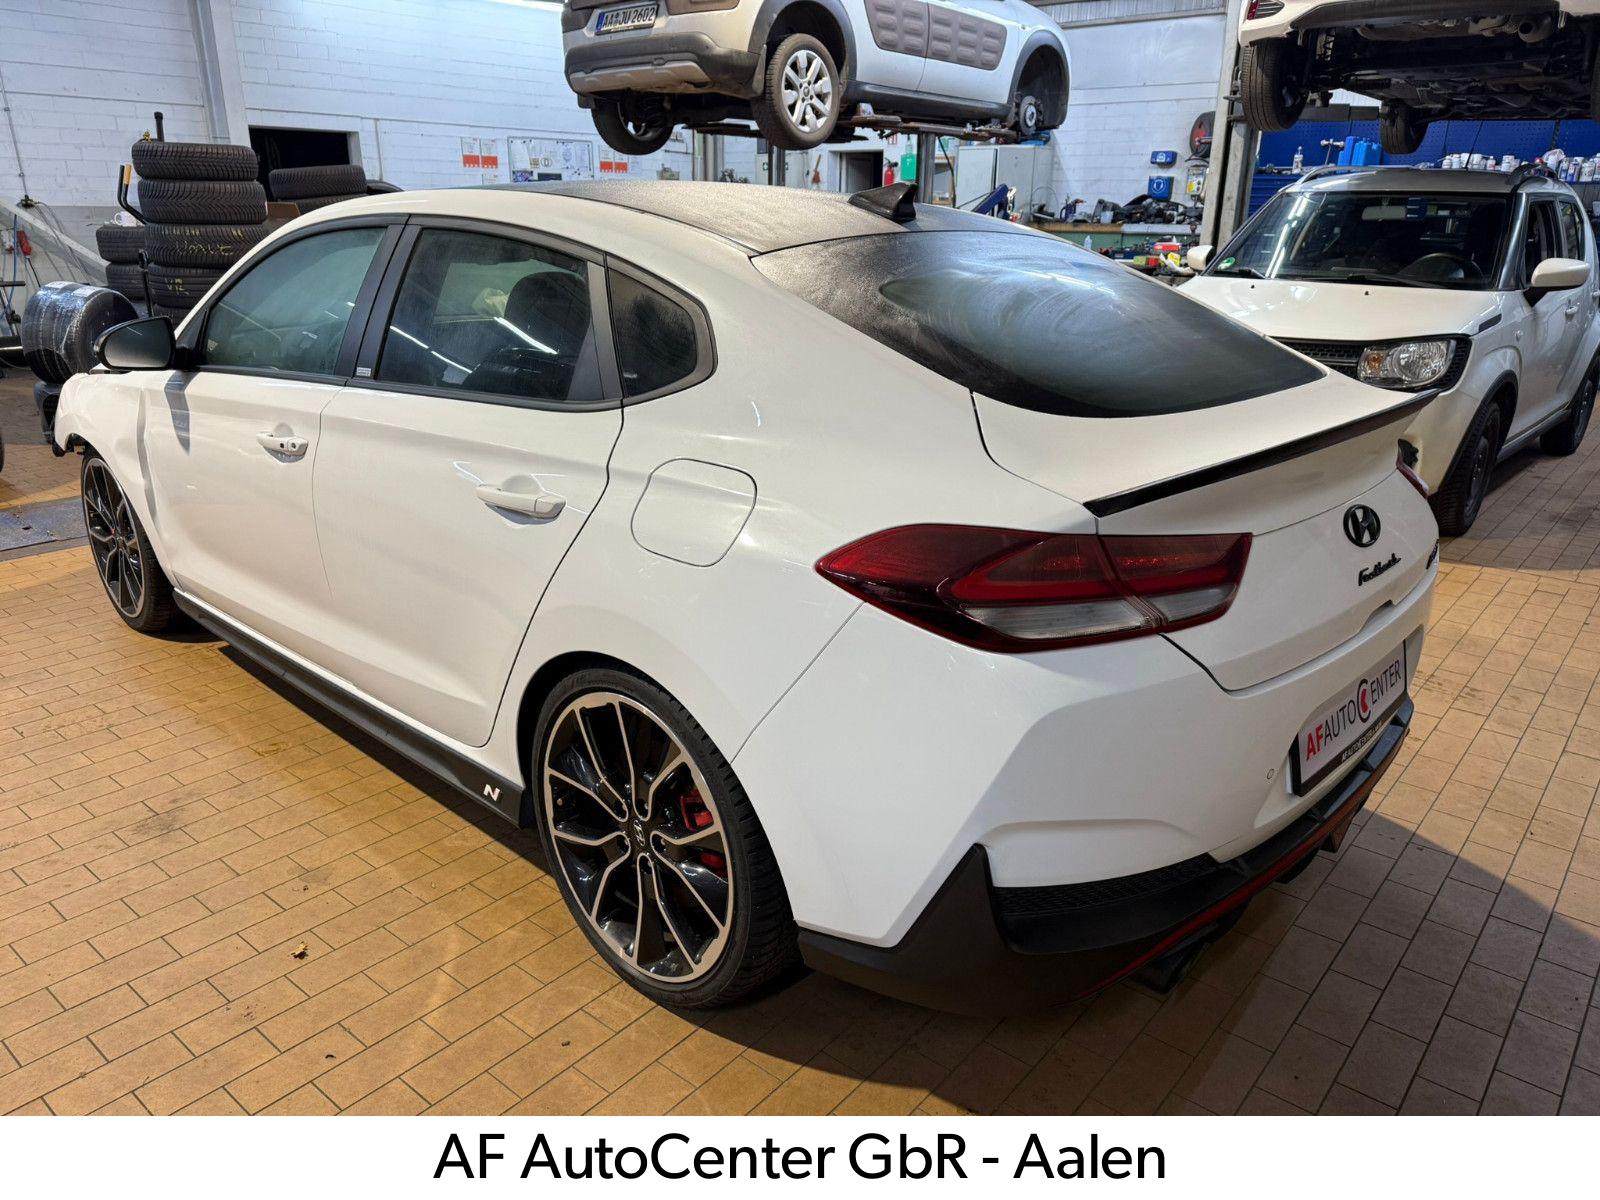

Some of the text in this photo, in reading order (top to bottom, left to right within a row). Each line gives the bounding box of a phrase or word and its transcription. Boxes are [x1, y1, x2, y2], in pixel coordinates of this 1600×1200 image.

[602, 14, 614, 28] AA
[632, 7, 655, 23] 2602
[483, 783, 500, 801] N
